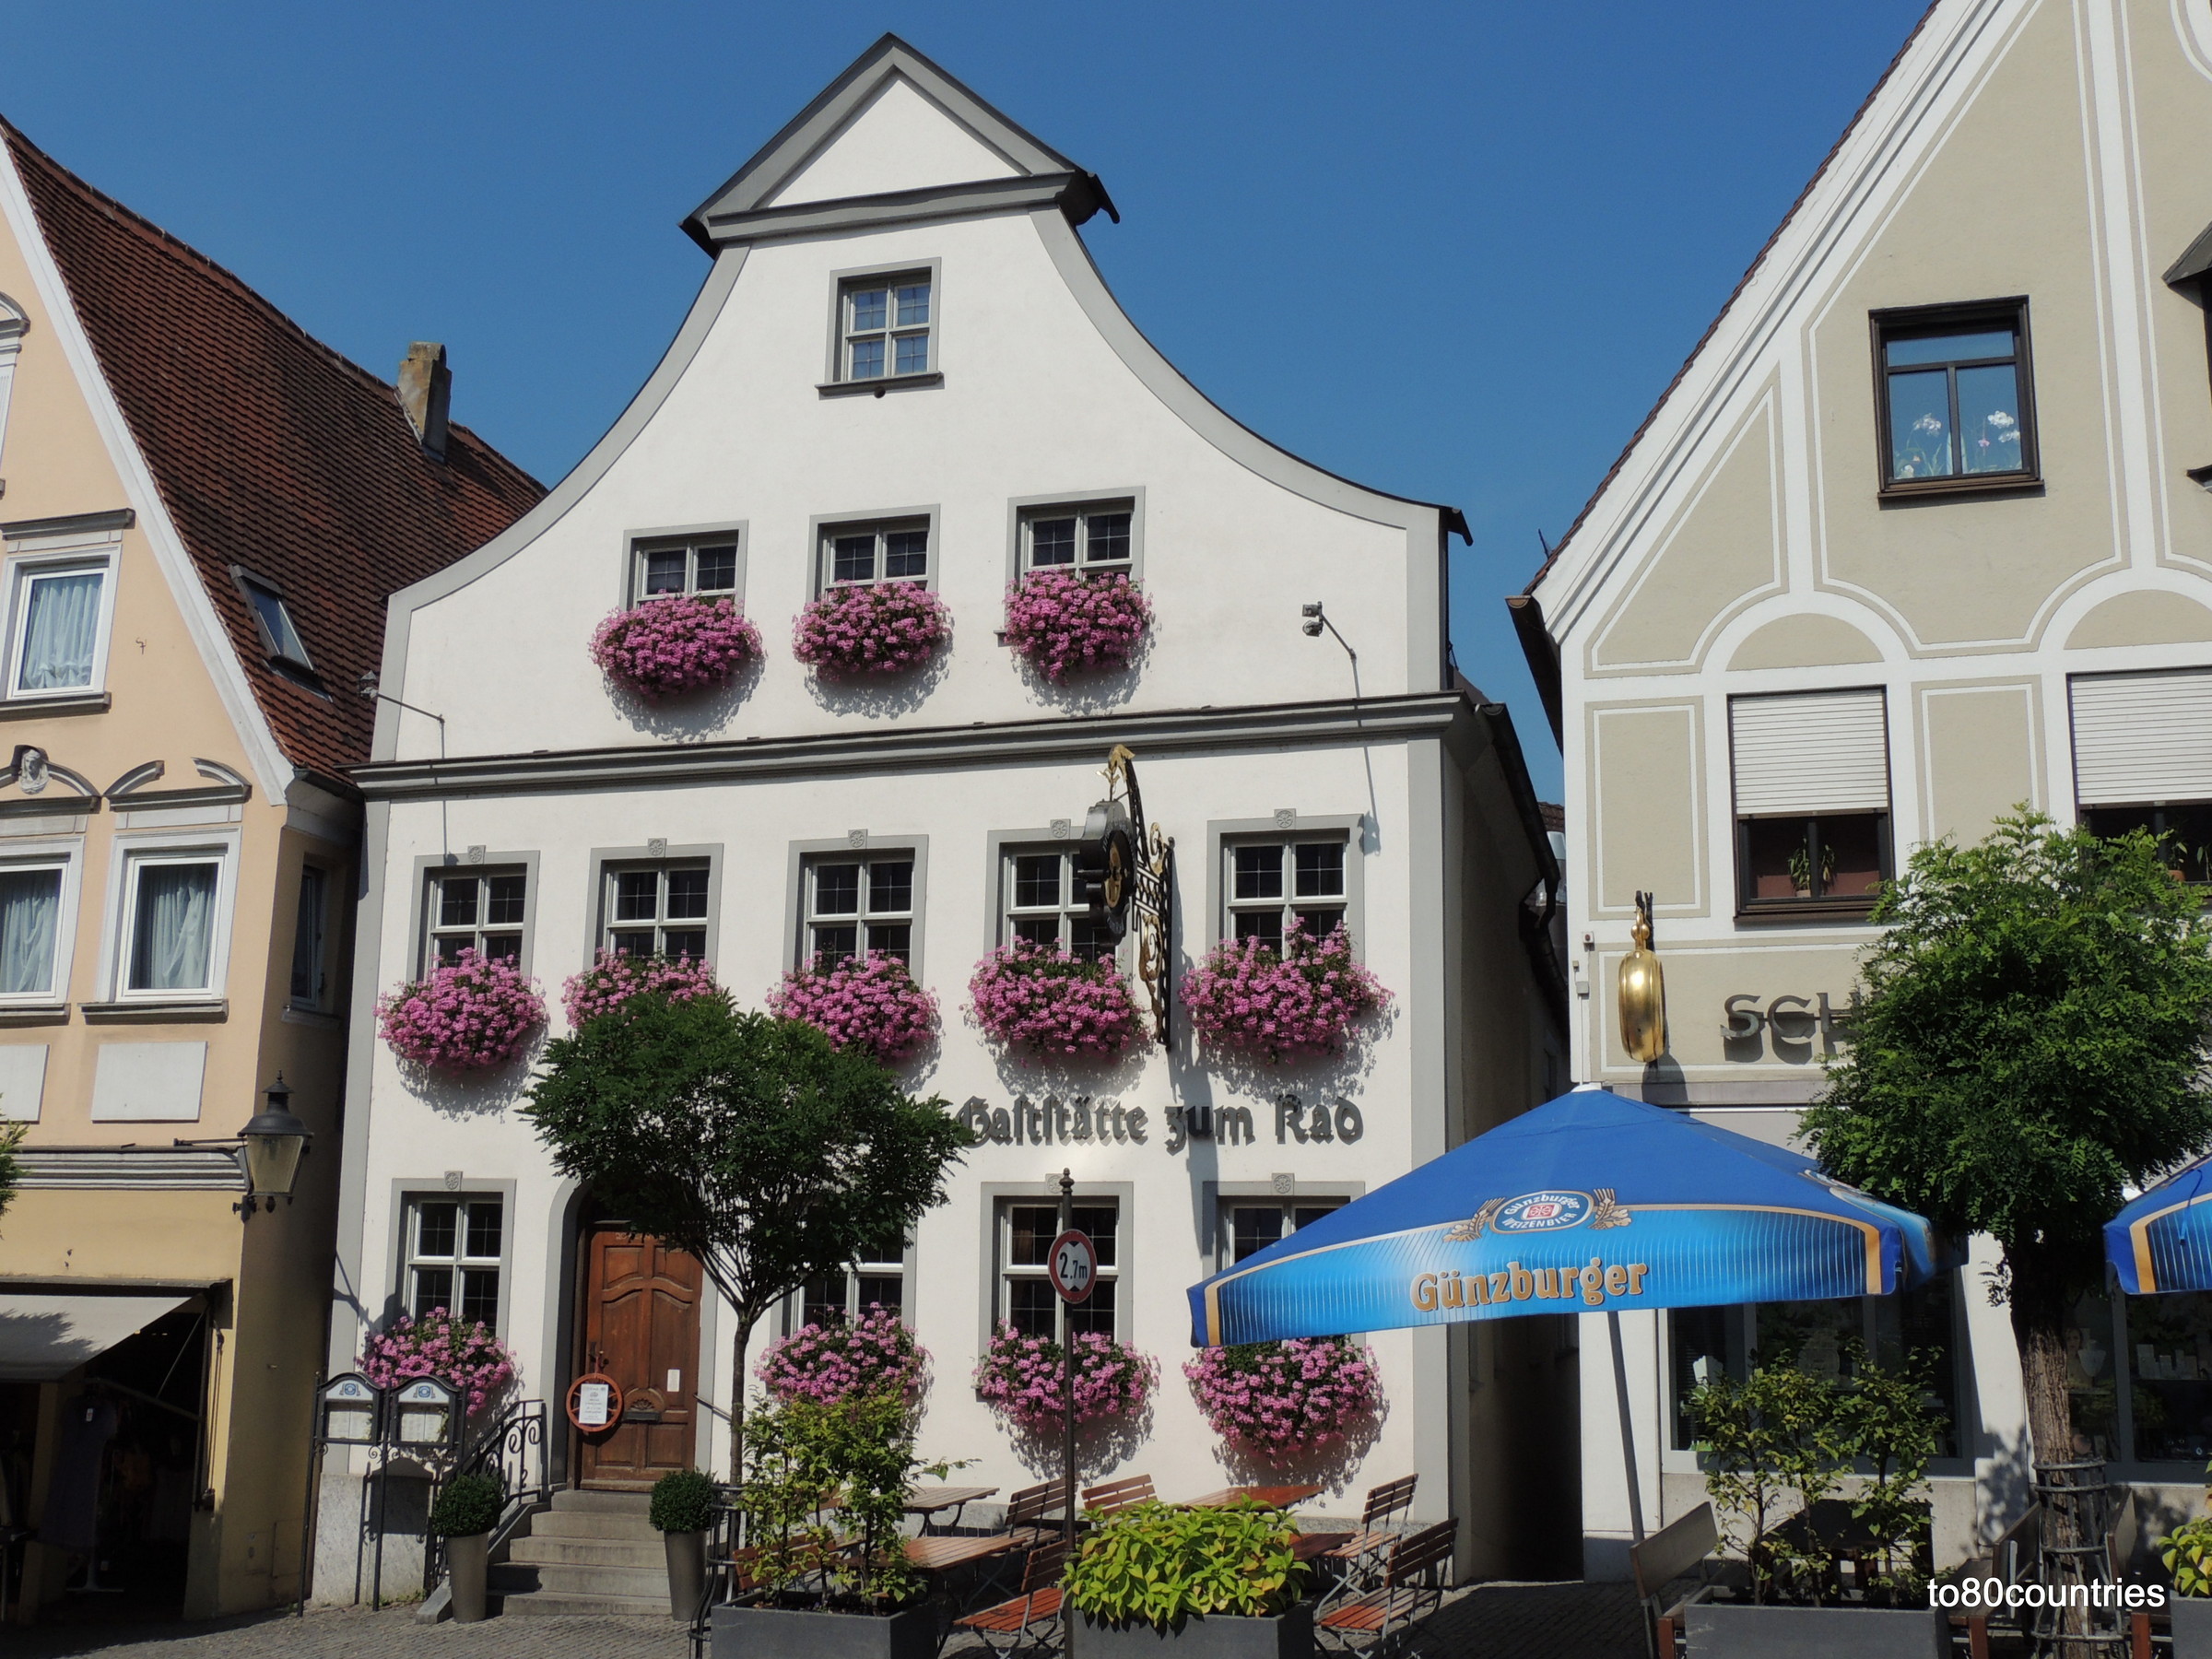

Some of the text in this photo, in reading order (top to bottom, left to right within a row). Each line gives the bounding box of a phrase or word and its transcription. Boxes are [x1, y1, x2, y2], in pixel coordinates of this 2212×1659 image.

[1720, 992, 1880, 1039] SCH
[1164, 1105, 1255, 1156] zum
[1275, 1094, 1364, 1146] Rad
[1501, 1210, 1578, 1230] WEIZENBIER
[1409, 1256, 1648, 1312] Günzburger
